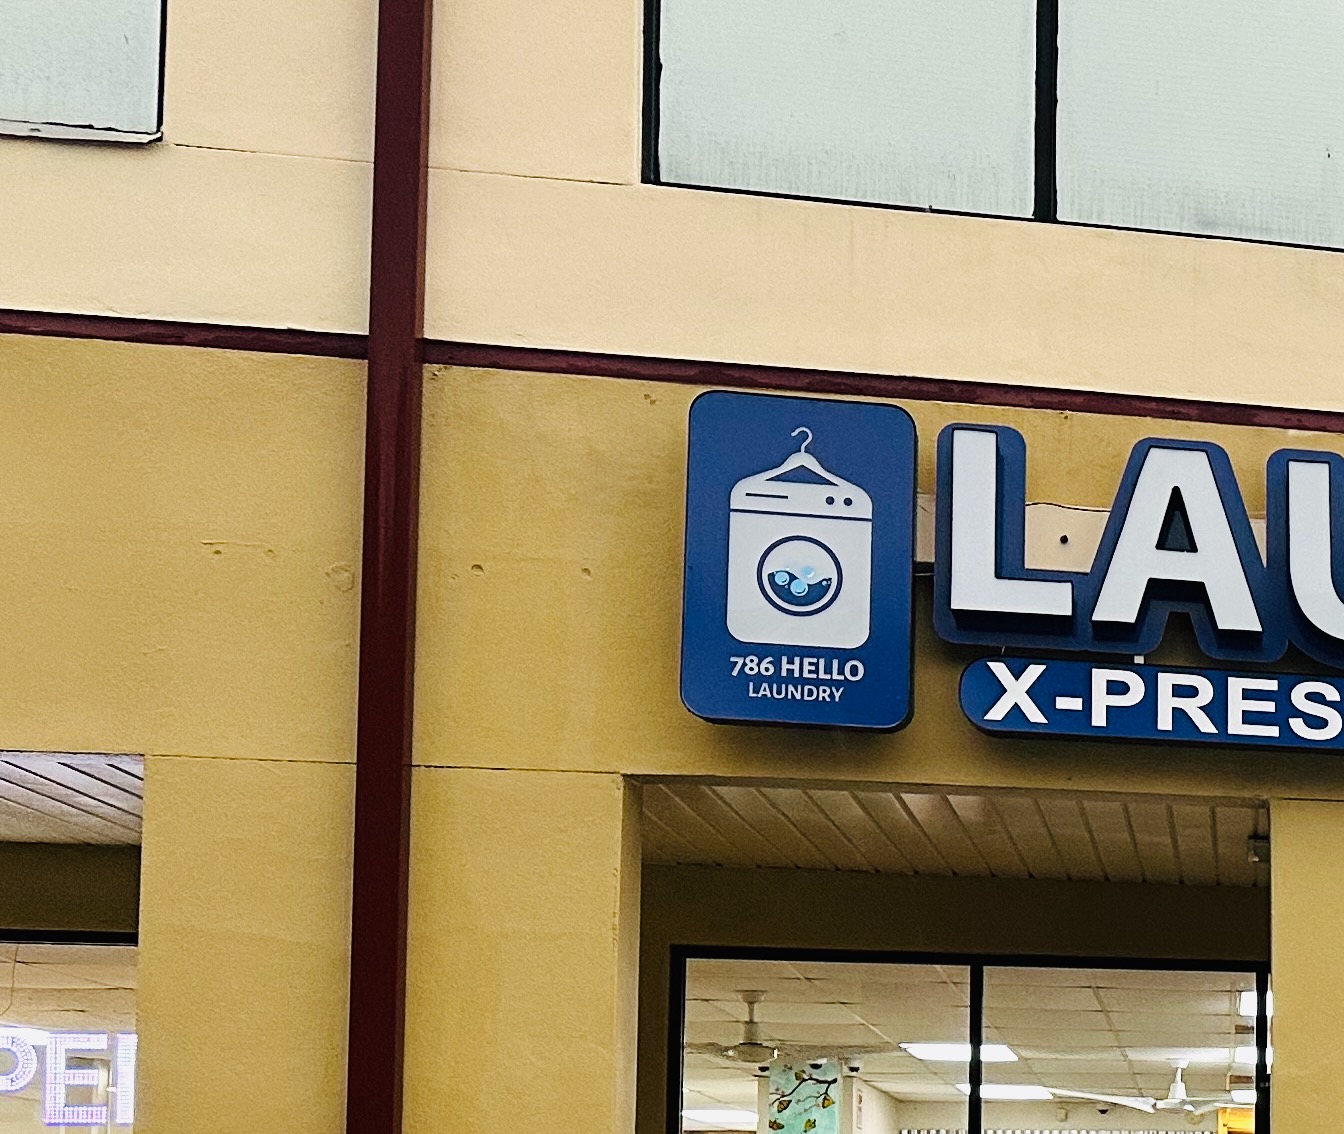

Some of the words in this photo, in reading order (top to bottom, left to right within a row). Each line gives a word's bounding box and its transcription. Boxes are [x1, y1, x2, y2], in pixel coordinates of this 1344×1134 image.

[730, 655, 775, 677] 786
[781, 655, 865, 681] HELLO
[748, 682, 845, 702] LAUNDRY
